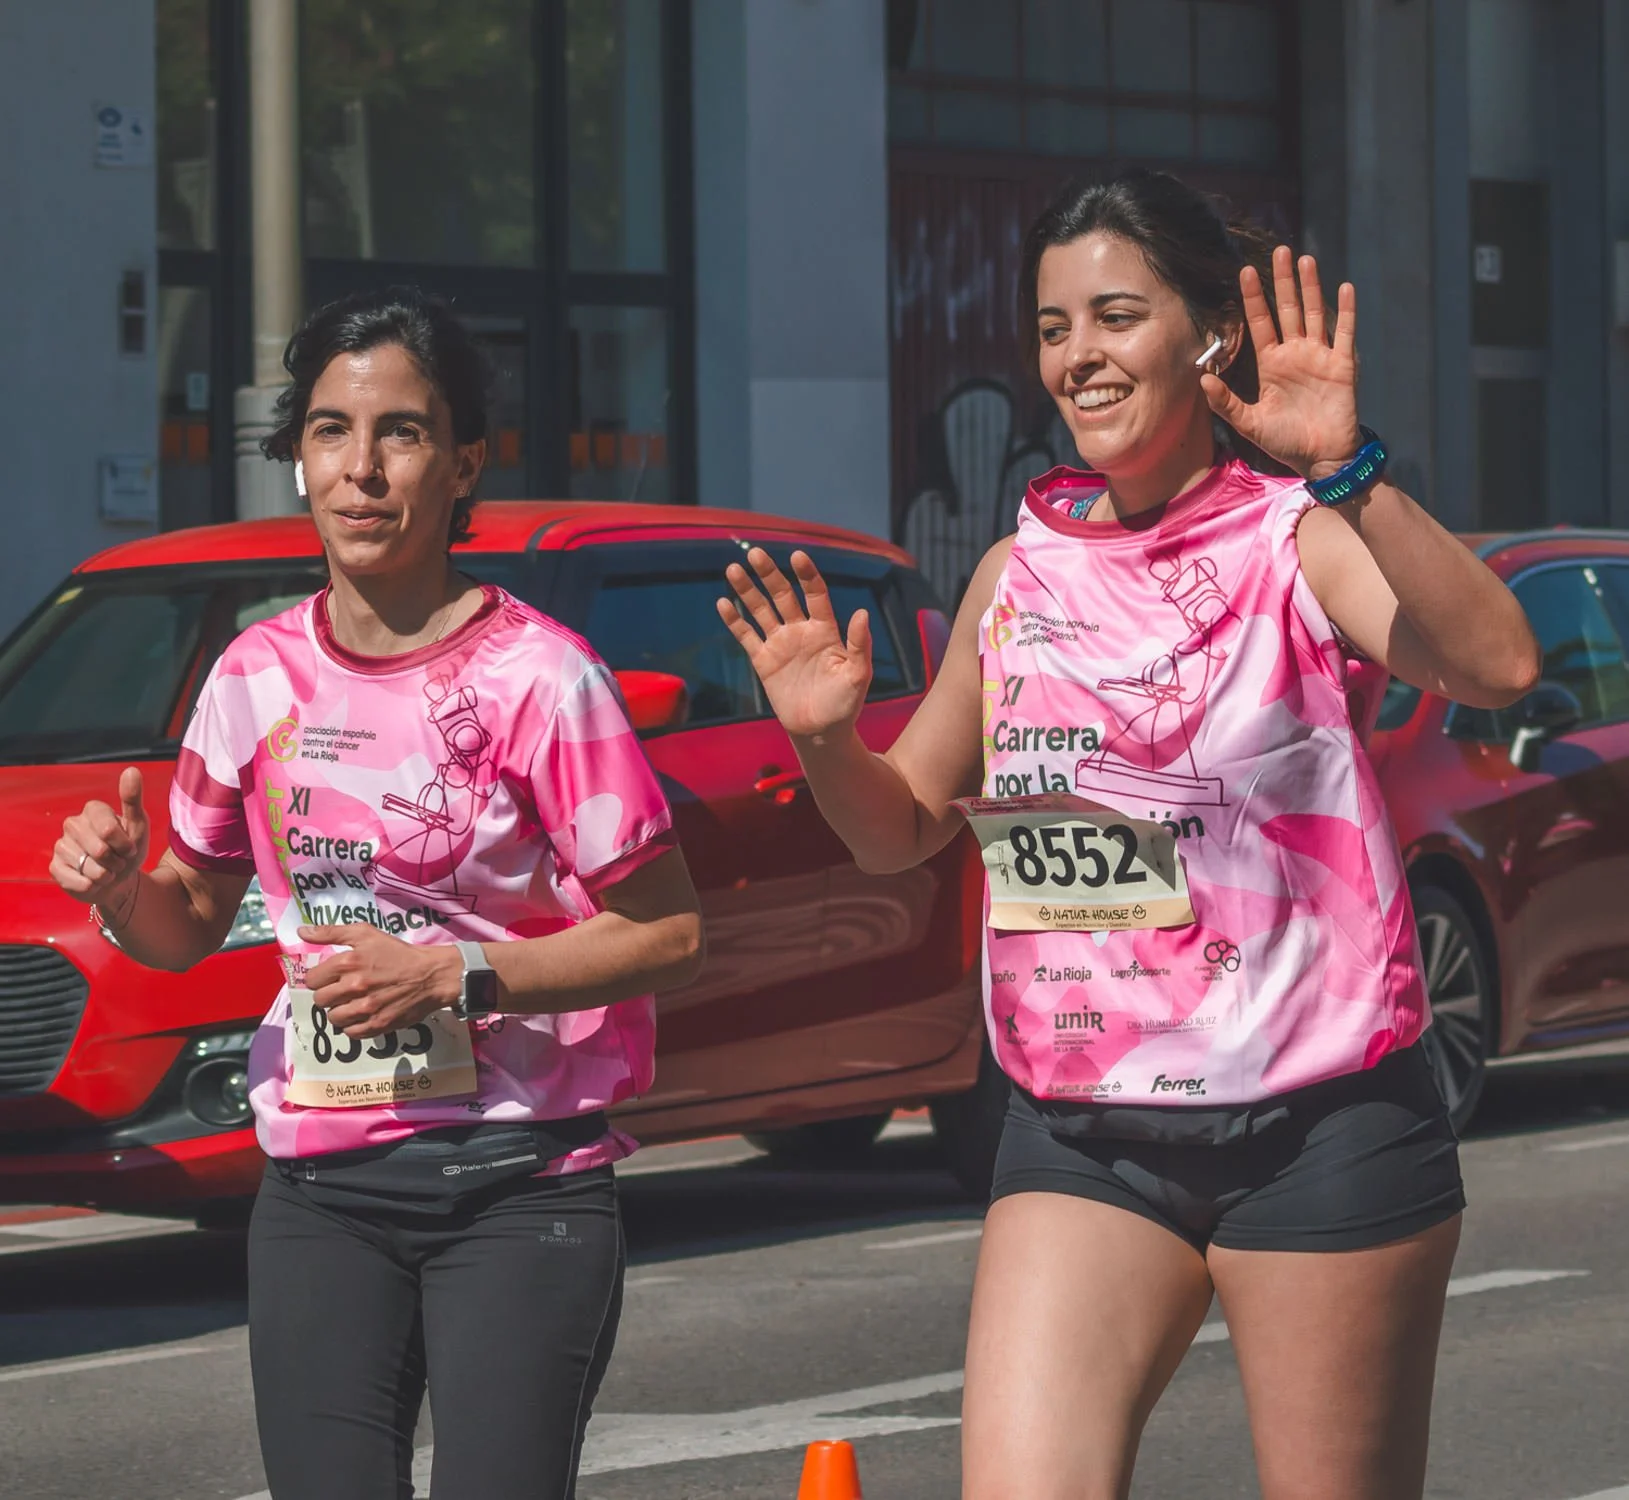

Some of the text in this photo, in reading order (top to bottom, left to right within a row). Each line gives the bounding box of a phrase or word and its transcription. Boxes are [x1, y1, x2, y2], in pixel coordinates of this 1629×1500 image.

[302, 737, 360, 750] contra el cáncer
[303, 726, 377, 741] asociación española
[993, 720, 1100, 752] Carrera
[310, 749, 319, 759] La
[320, 750, 339, 763] Rioja
[995, 764, 1072, 798] por la
[287, 786, 311, 817] XI
[286, 827, 373, 863] Carrera
[1008, 823, 1148, 888] 8552
[292, 868, 367, 899] por la
[1053, 908, 1129, 921] NATUR HOUSE
[1049, 966, 1092, 983] La Rioja
[336, 1079, 415, 1097] NATUR HOUSE
